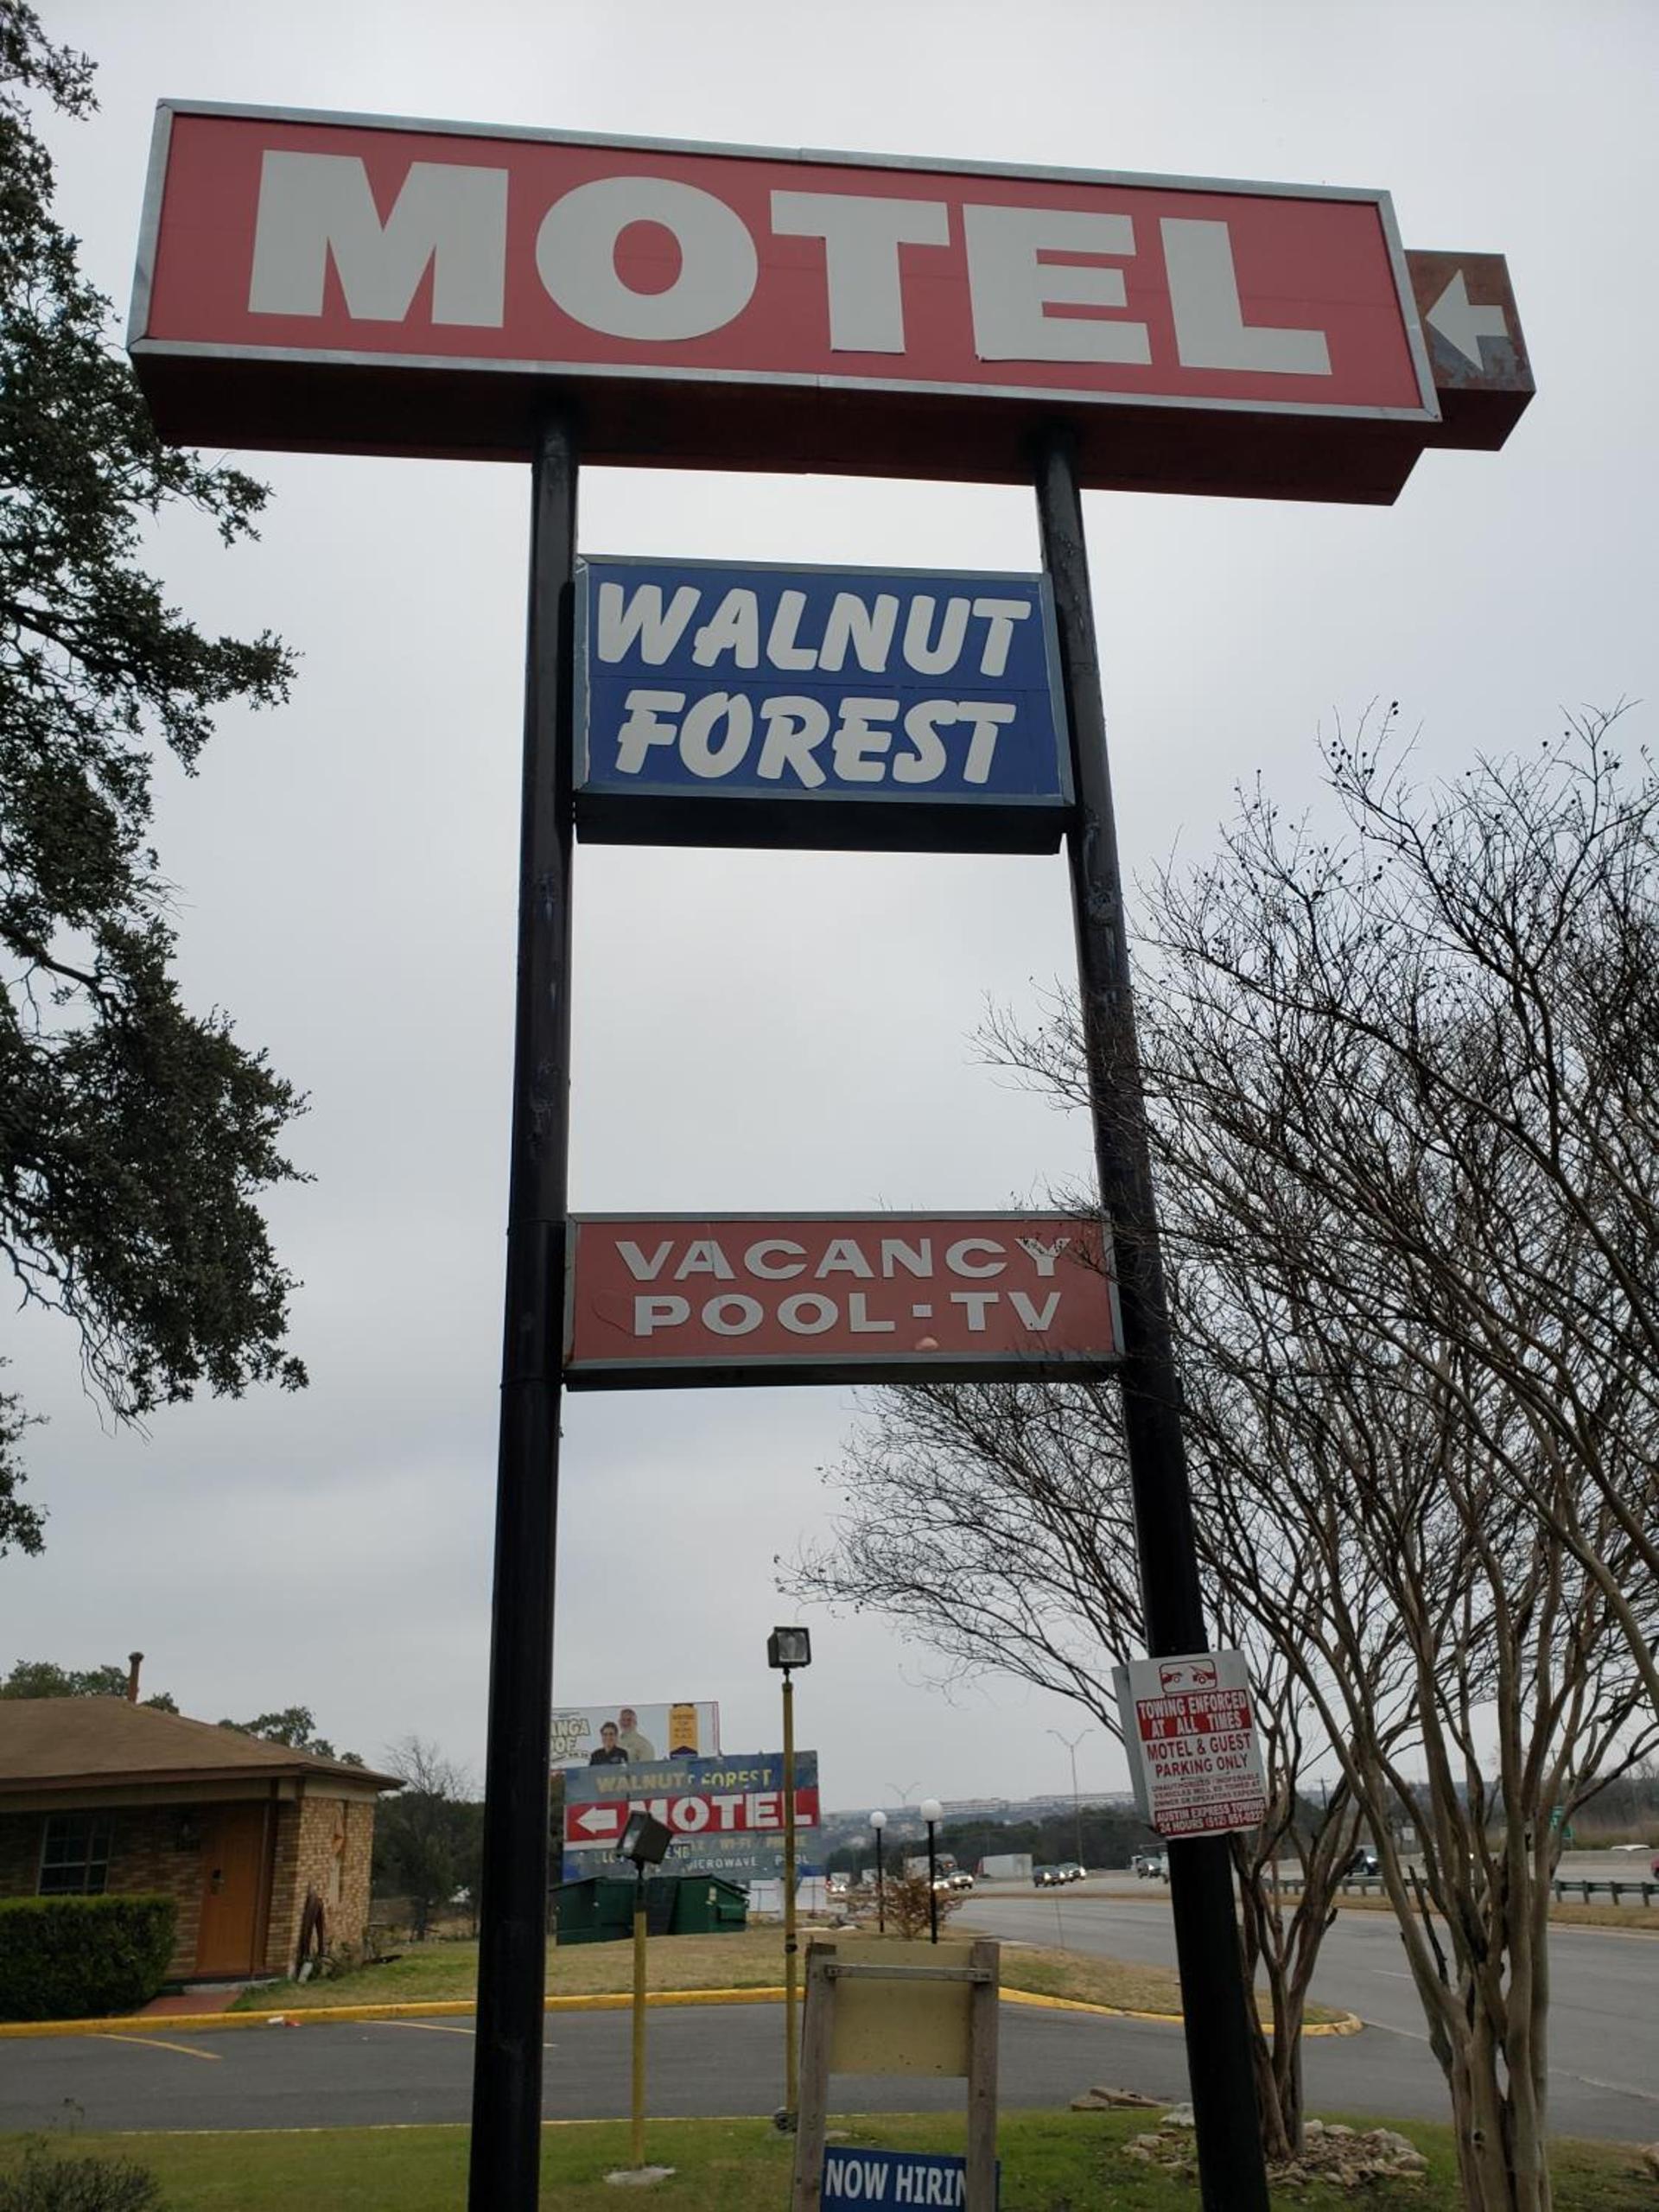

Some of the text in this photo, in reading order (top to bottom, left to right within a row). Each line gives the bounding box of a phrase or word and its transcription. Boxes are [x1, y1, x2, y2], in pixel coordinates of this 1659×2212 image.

[248, 149, 1333, 377] MOTEL
[598, 582, 1032, 677] WALNUT
[615, 690, 1017, 790] FOREST
[615, 1237, 1071, 1281] VACANCY
[633, 1291, 1062, 1337] POOL TV
[1138, 1691, 1247, 1720] TOWING ENFORCED
[1151, 1710, 1243, 1738] AT ALL TIMES
[1147, 1732, 1251, 1763] MOTEL & GUEST
[1155, 1753, 1249, 1778] PARKING ONLY
[596, 1772, 685, 1794] WALNUT
[1157, 1808, 1191, 1823] AUSTIN
[775, 1853, 810, 1867] POL
[825, 2158, 967, 2207] NOW HIRIN
